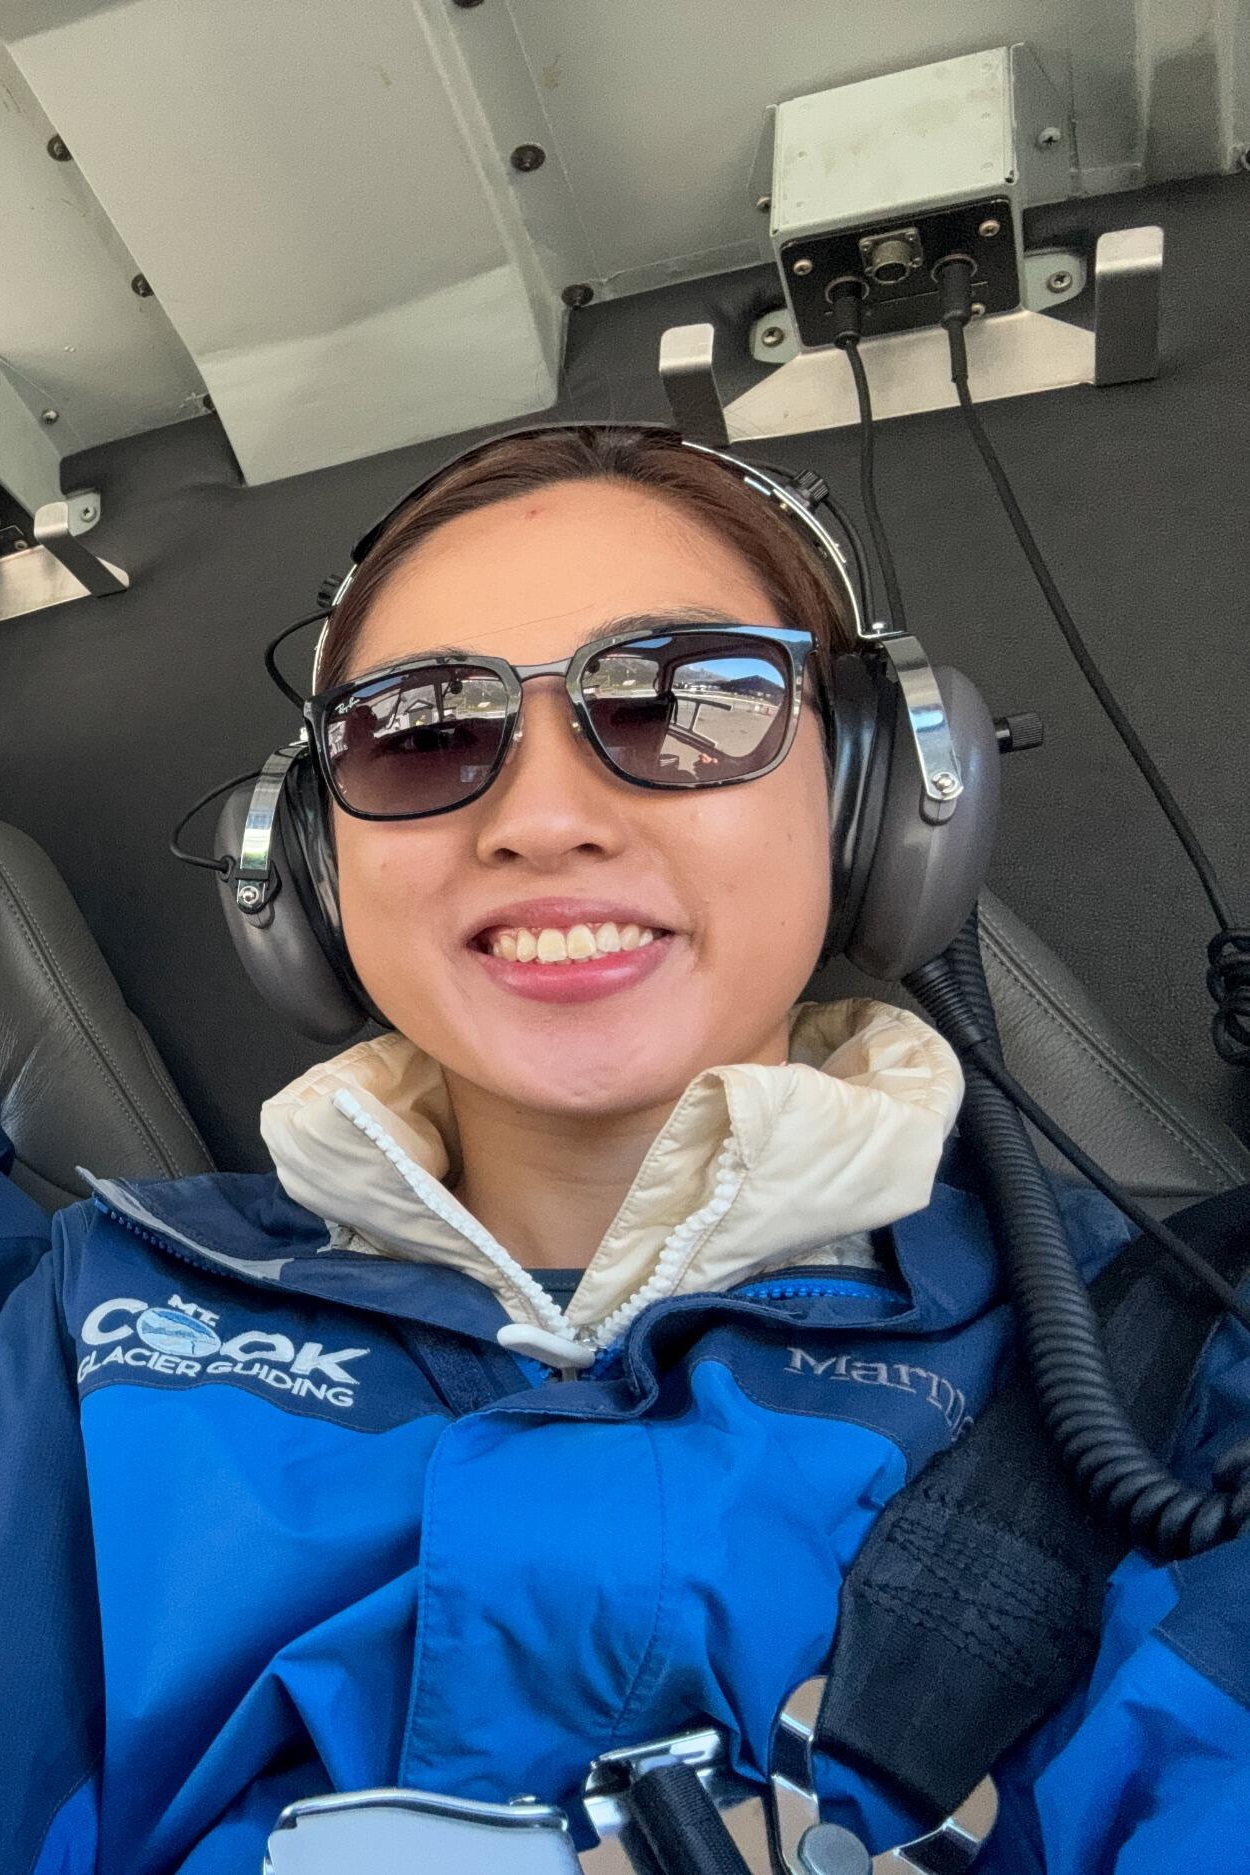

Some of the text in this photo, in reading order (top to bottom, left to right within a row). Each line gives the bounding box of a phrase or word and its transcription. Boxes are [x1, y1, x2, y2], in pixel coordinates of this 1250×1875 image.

[77, 1346, 354, 1407] GLACIER GUIDING
[81, 1298, 370, 1385] COOK
